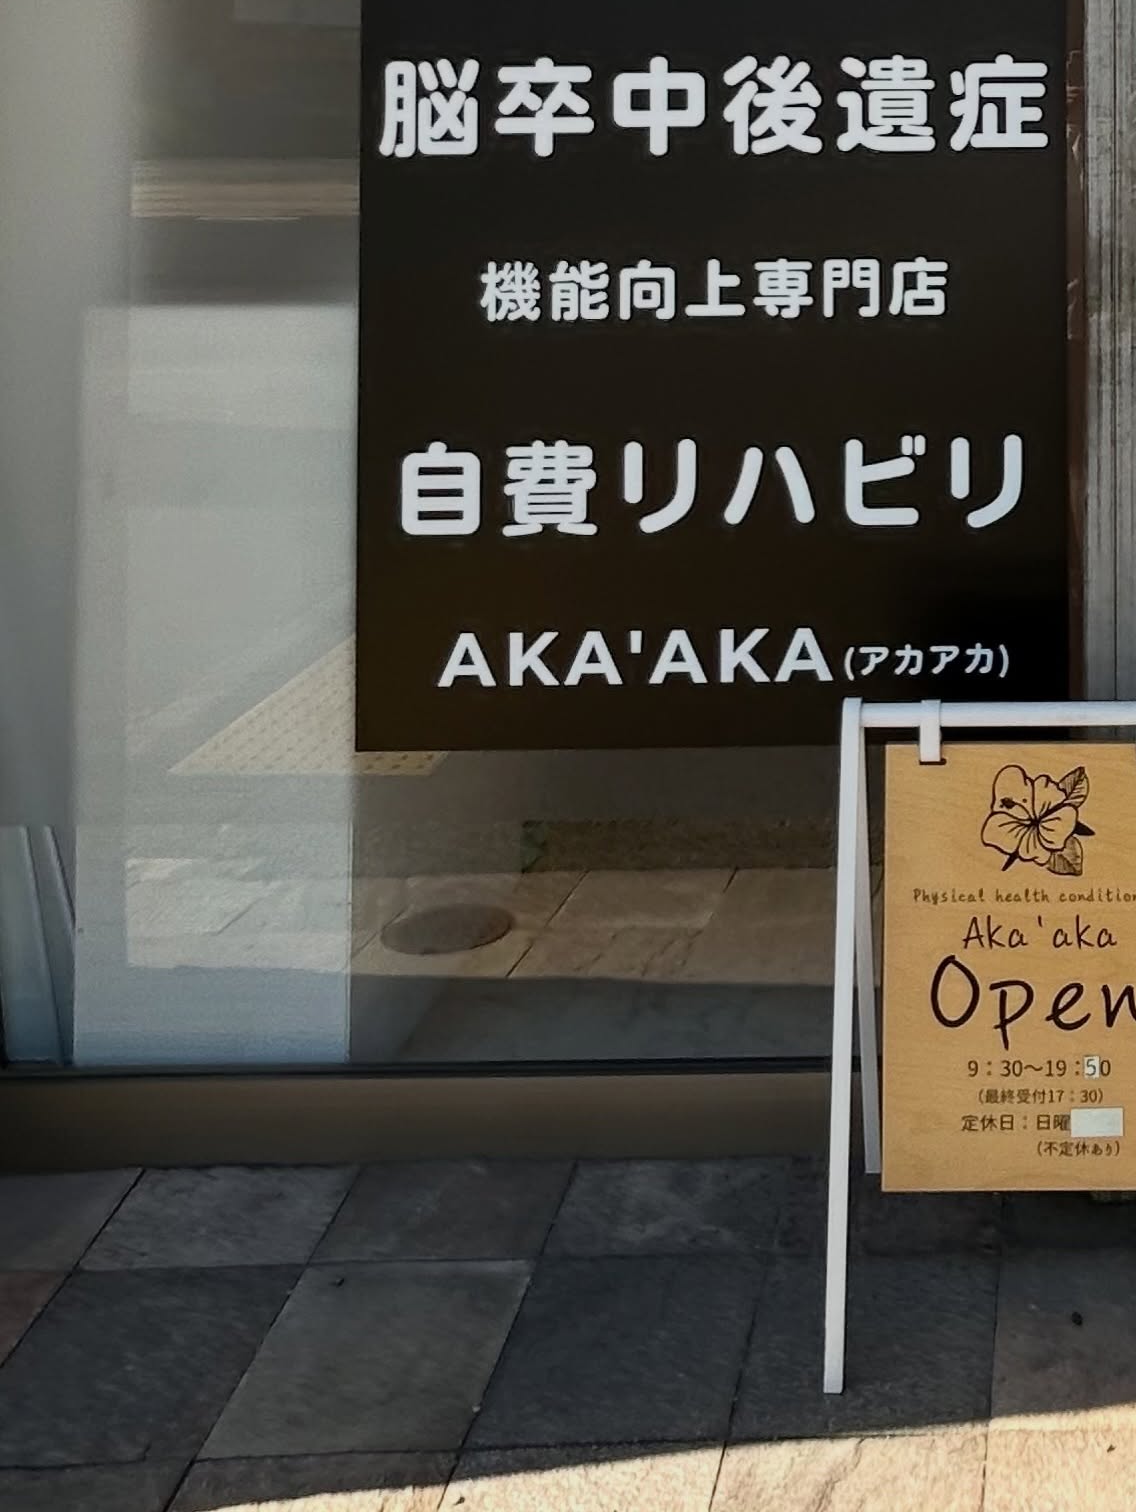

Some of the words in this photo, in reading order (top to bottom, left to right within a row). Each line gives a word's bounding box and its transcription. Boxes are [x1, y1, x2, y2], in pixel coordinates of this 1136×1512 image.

[378, 54, 1049, 158] 脳卒中後遺症
[479, 256, 949, 322] 機能向上専門店
[401, 434, 1023, 537] 自費リハビリ
[437, 627, 834, 688] AKA'AKA
[912, 887, 985, 906] Physical
[995, 887, 1050, 904] health
